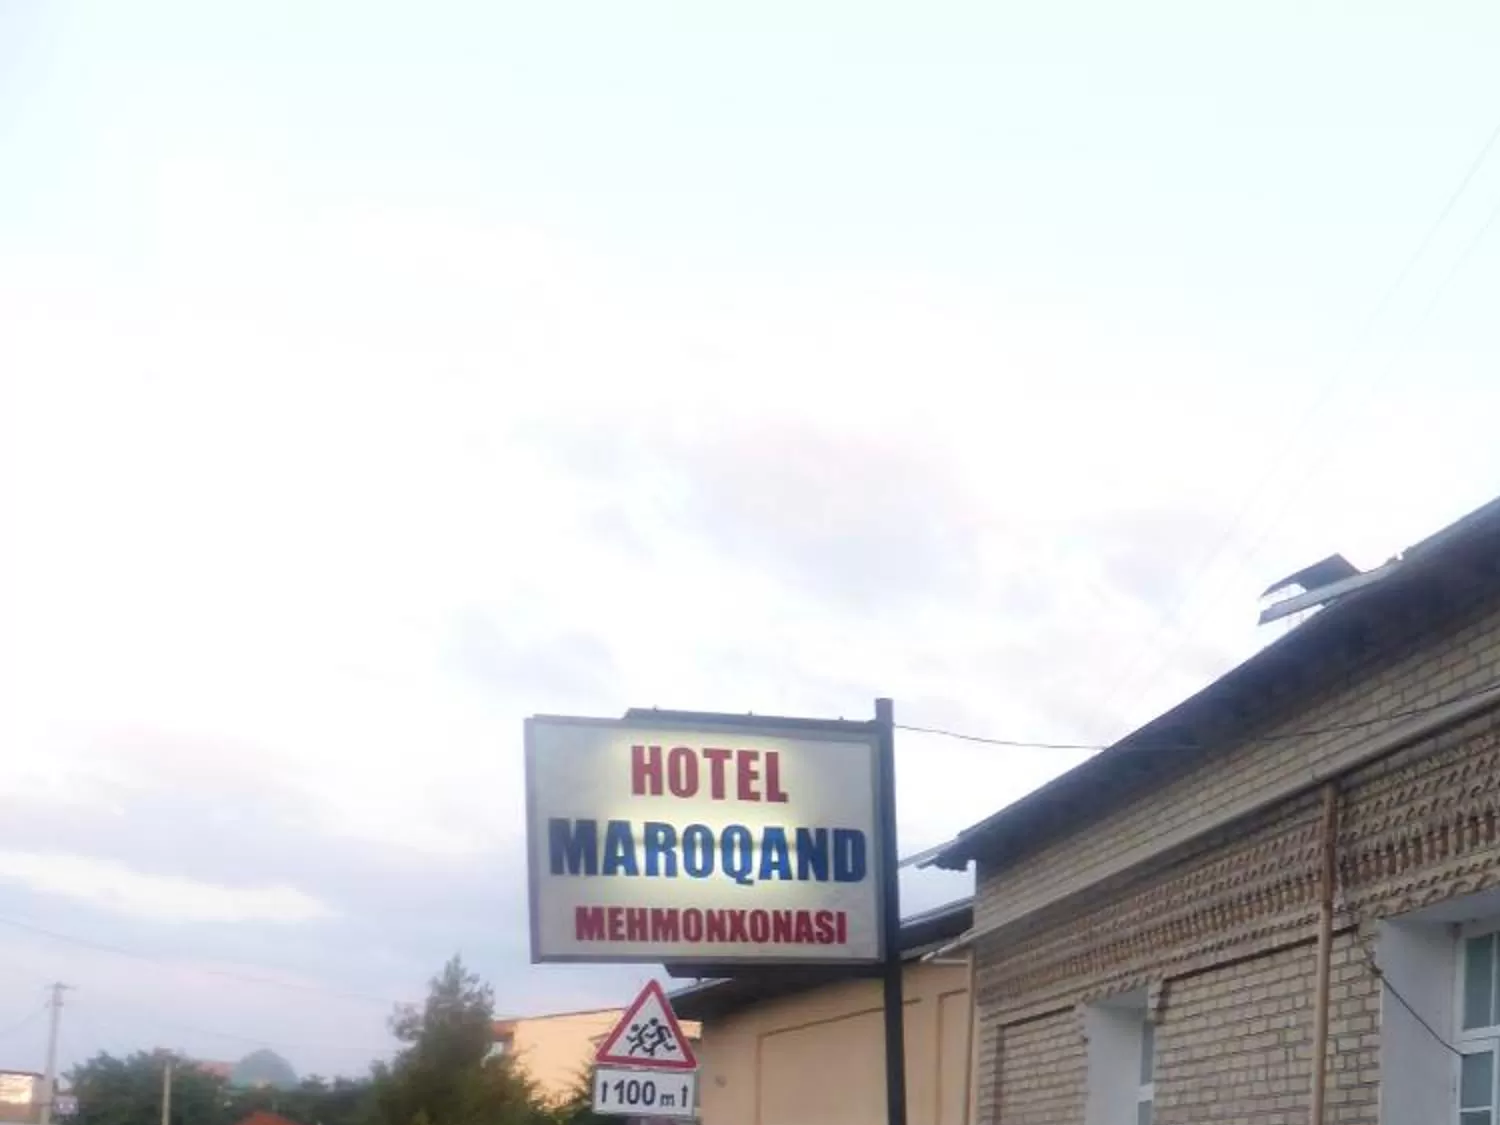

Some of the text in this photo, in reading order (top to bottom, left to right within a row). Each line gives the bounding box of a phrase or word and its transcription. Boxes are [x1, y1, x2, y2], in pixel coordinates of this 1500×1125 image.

[631, 745, 788, 803] HOTEL
[548, 818, 866, 885] MAROQAND
[575, 906, 847, 945] MEHMONXONASI
[613, 1079, 656, 1106] 100
